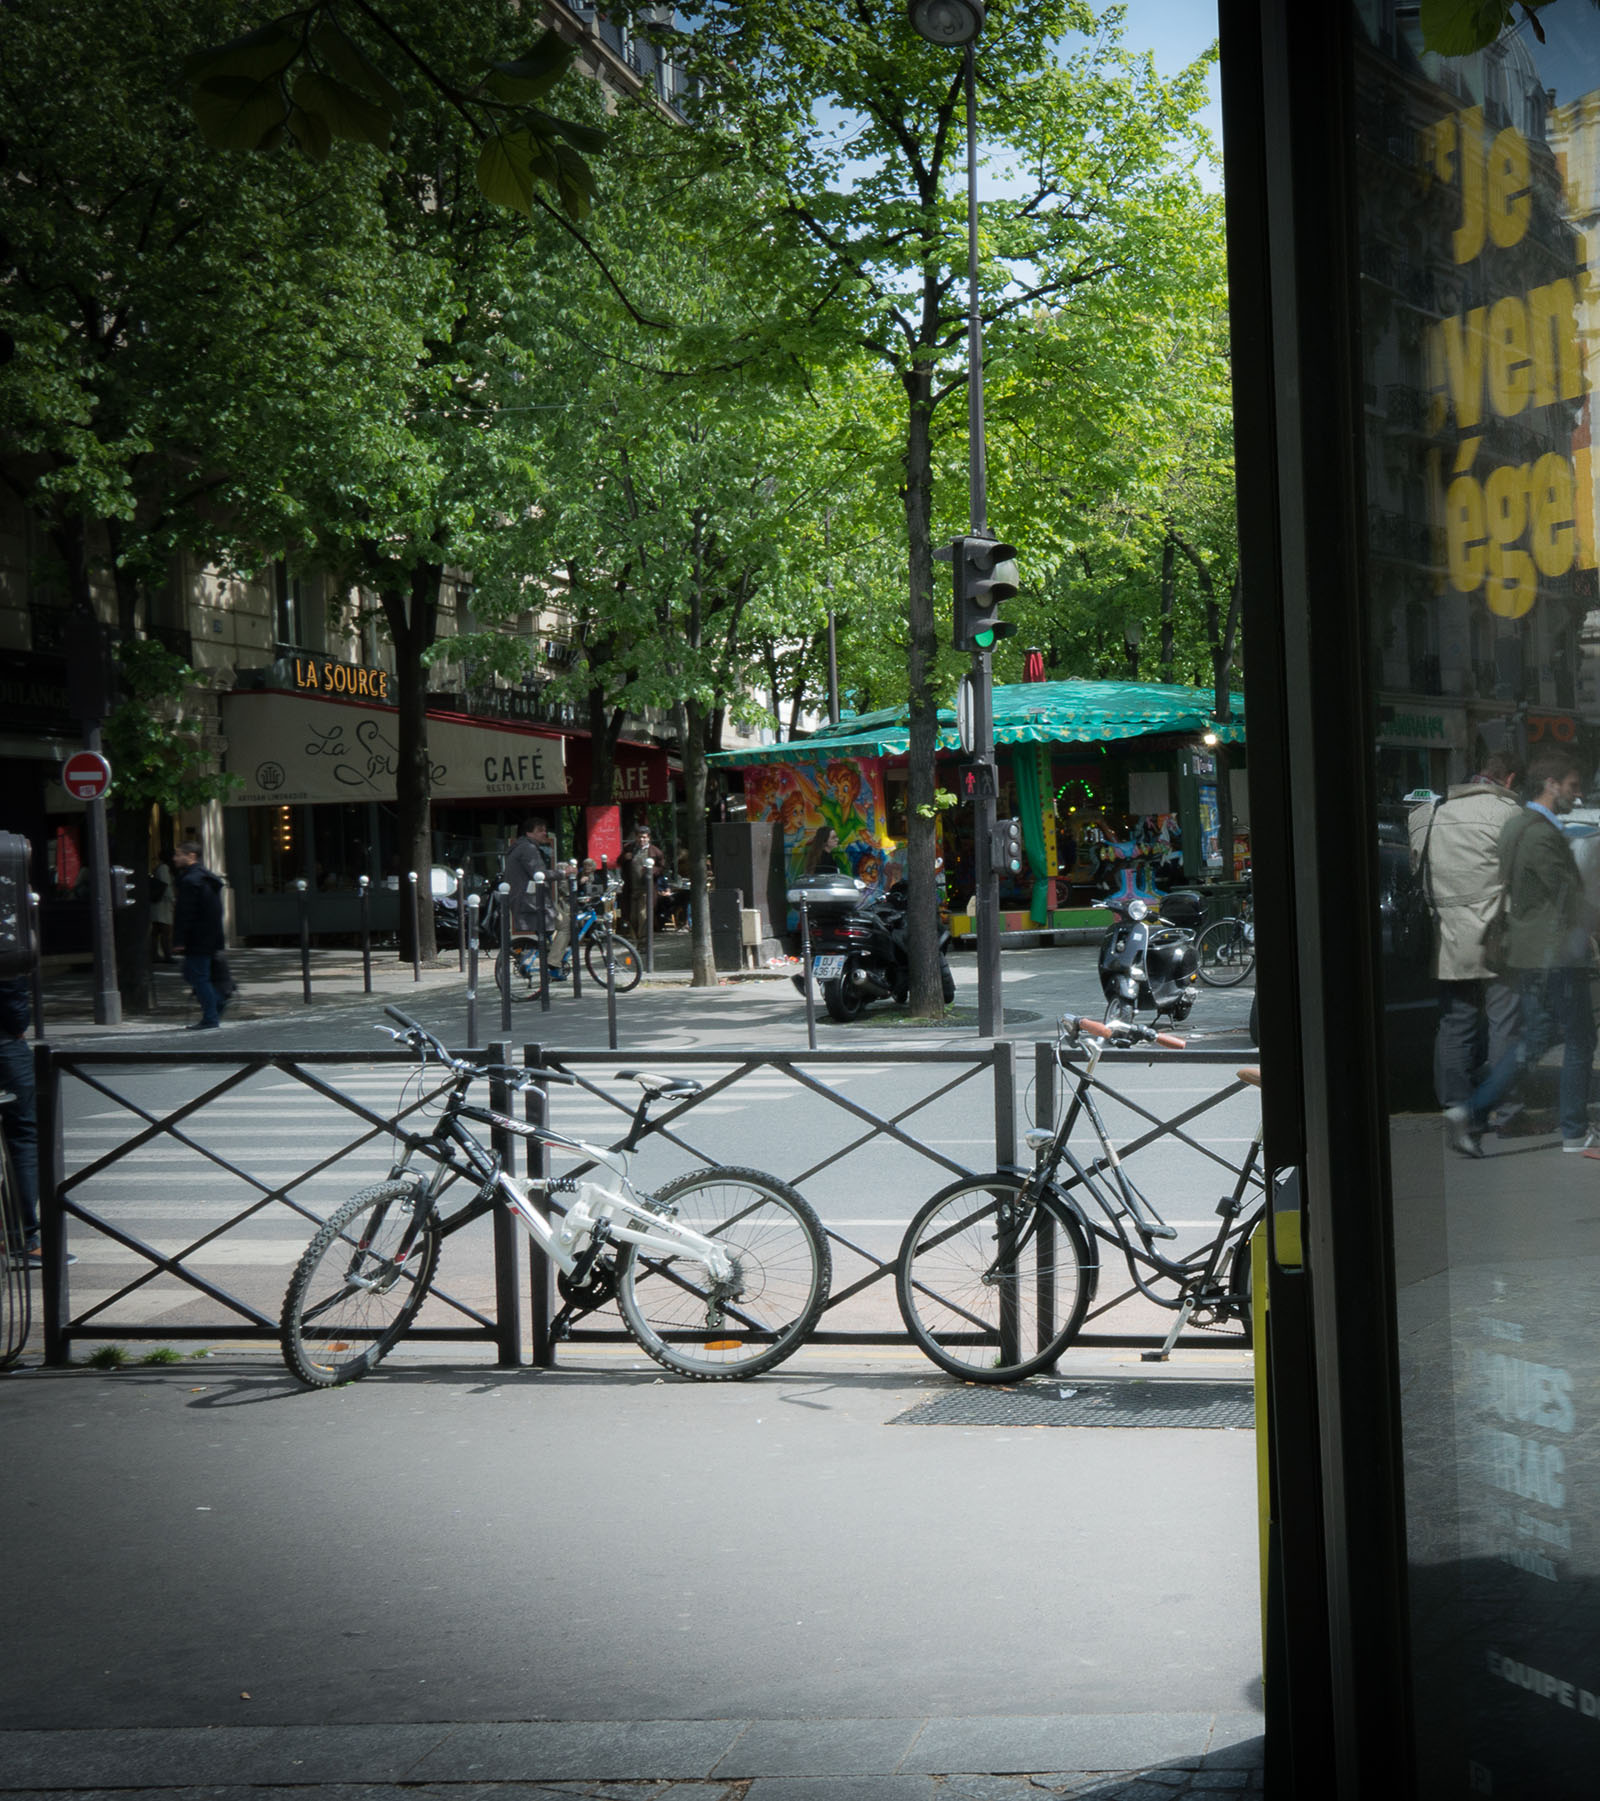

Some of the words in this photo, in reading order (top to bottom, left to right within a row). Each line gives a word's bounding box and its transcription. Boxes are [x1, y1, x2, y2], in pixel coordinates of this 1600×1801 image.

[295, 658, 318, 688] LA
[324, 662, 388, 698] SOURCE
[305, 723, 349, 756] La
[484, 748, 545, 782] CAFÉ
[613, 762, 650, 790] AFÉ
[522, 782, 546, 791] PIZZA
